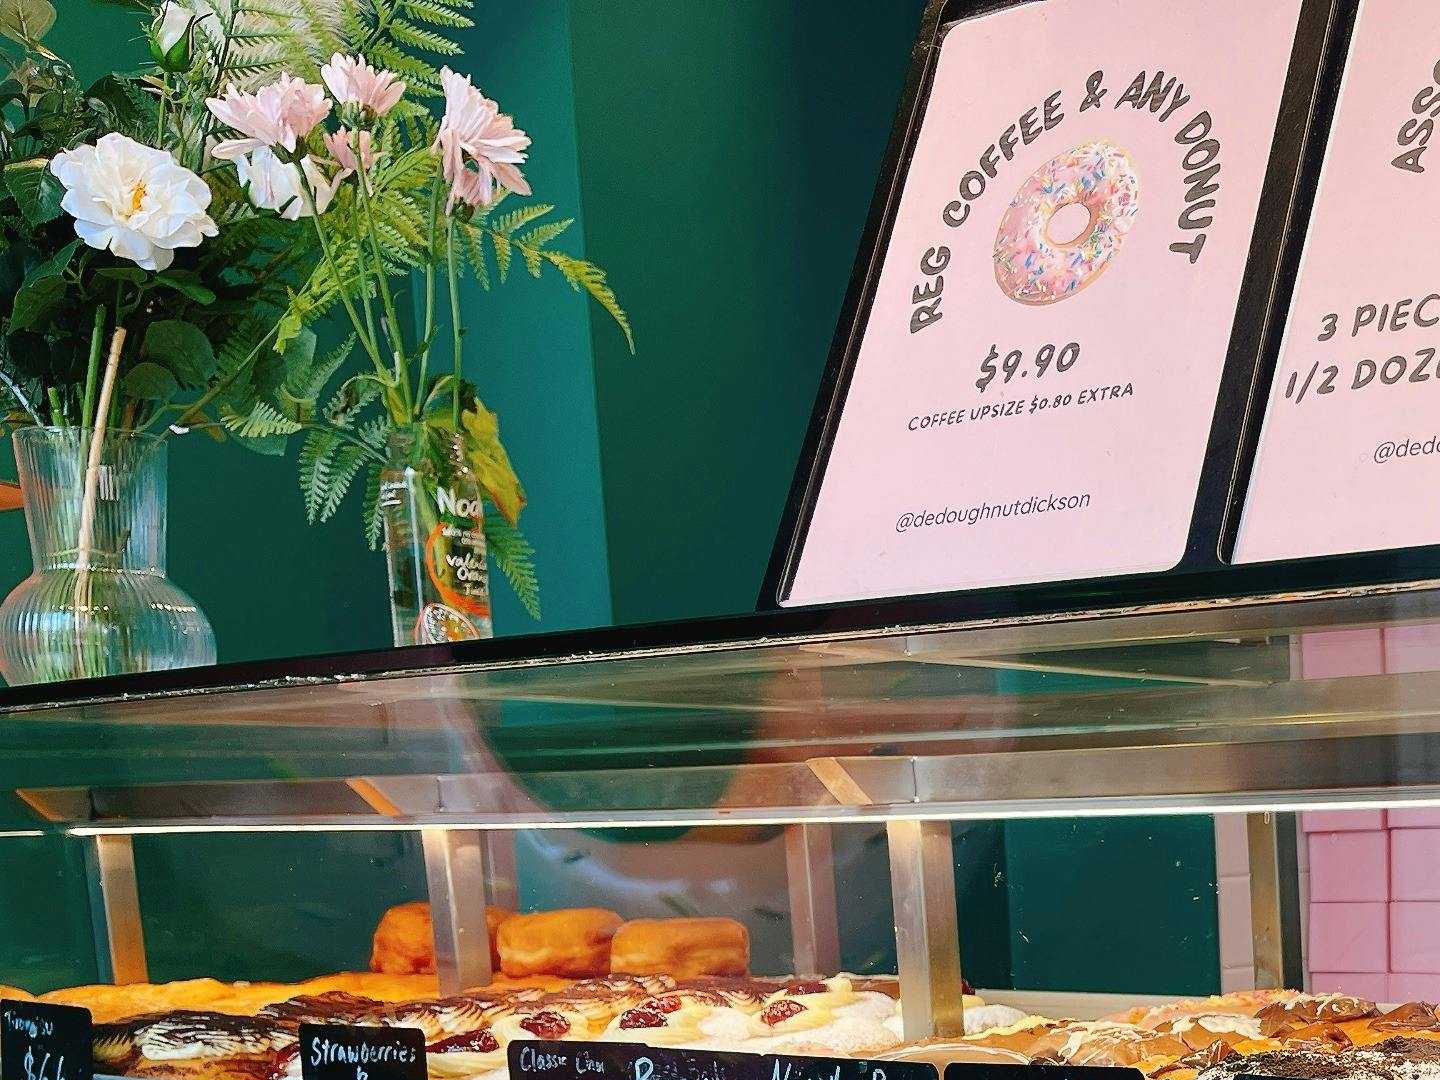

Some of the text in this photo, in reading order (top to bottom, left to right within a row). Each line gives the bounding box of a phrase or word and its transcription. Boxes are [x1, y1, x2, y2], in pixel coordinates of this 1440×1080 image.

[910, 70, 1222, 334] REG COFFEE & ANY DONUT
[1317, 313, 1339, 342] 3
[975, 342, 1081, 392] $9.90
[1285, 360, 1337, 404] 1/2
[907, 382, 1134, 432] COFFEE UPSIZE $0.80 EXTRA
[895, 490, 1092, 533] @dedoughnutdickson
[311, 1036, 417, 1067] Strawberries
